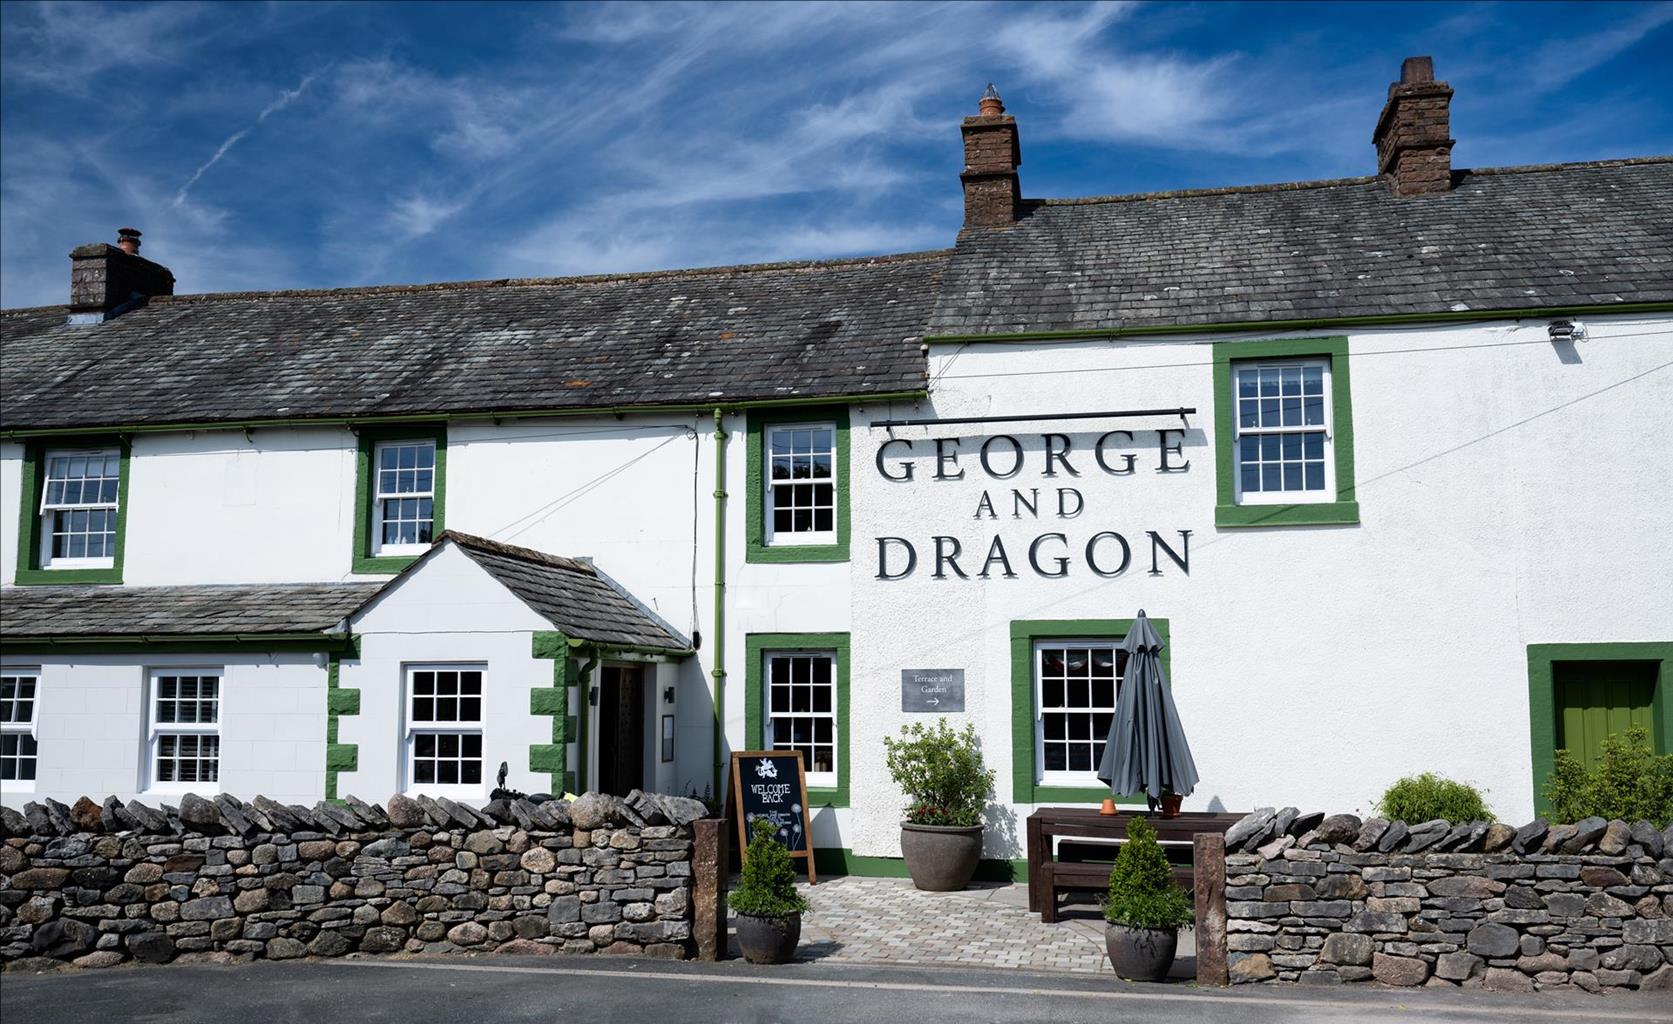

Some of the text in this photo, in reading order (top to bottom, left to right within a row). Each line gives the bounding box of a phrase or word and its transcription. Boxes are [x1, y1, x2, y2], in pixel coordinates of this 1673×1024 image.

[875, 428, 1190, 481] GEORGE
[974, 487, 1084, 519] AND
[875, 529, 1192, 579] DRAGON
[913, 674, 953, 682] Terrace and
[921, 685, 947, 693] Garden
[751, 784, 791, 794] WELCOME
[762, 793, 784, 803] BACK
